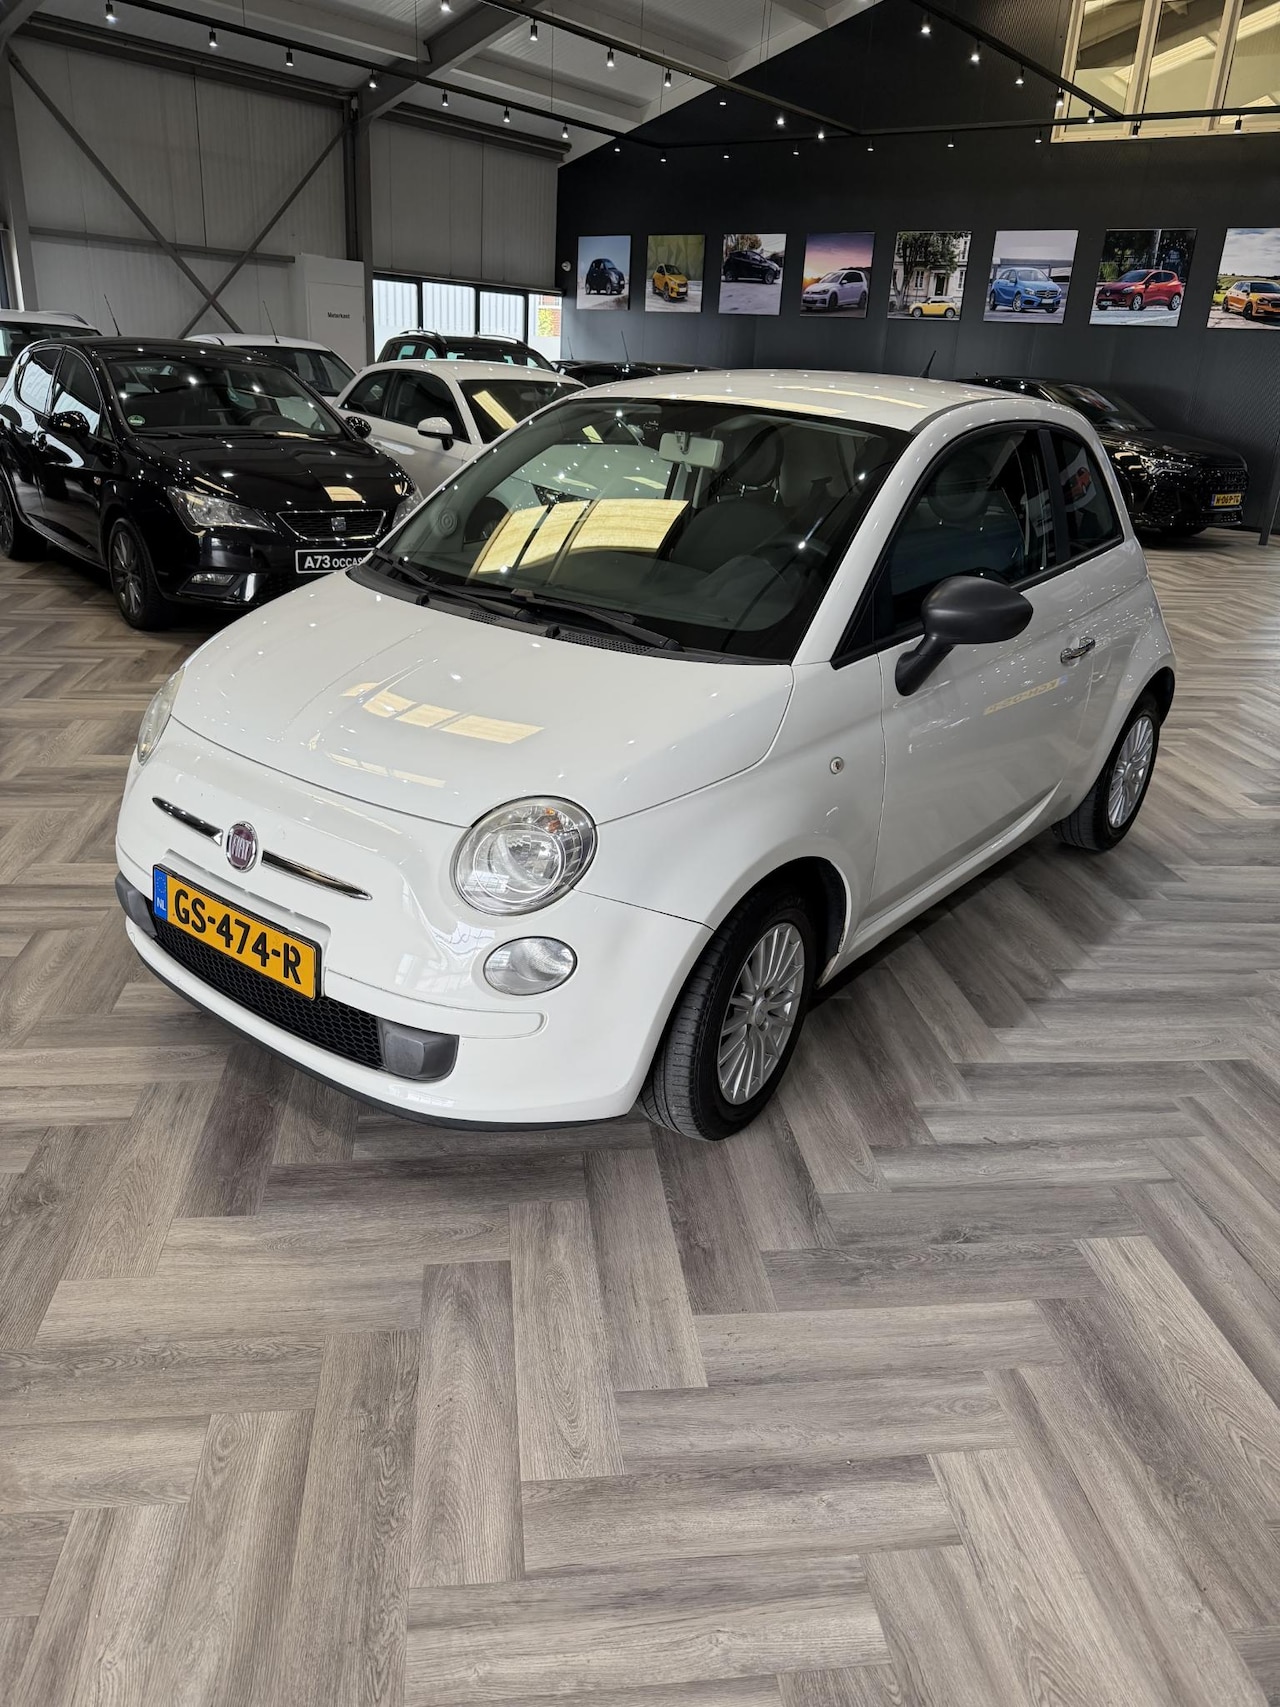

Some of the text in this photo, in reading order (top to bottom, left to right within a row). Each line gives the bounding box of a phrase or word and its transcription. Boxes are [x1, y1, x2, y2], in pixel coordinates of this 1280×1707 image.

[304, 555, 364, 569] A73 OCCAS
[232, 834, 251, 861] FIAT
[156, 896, 167, 912] NL
[174, 888, 302, 985] GS-474-R
